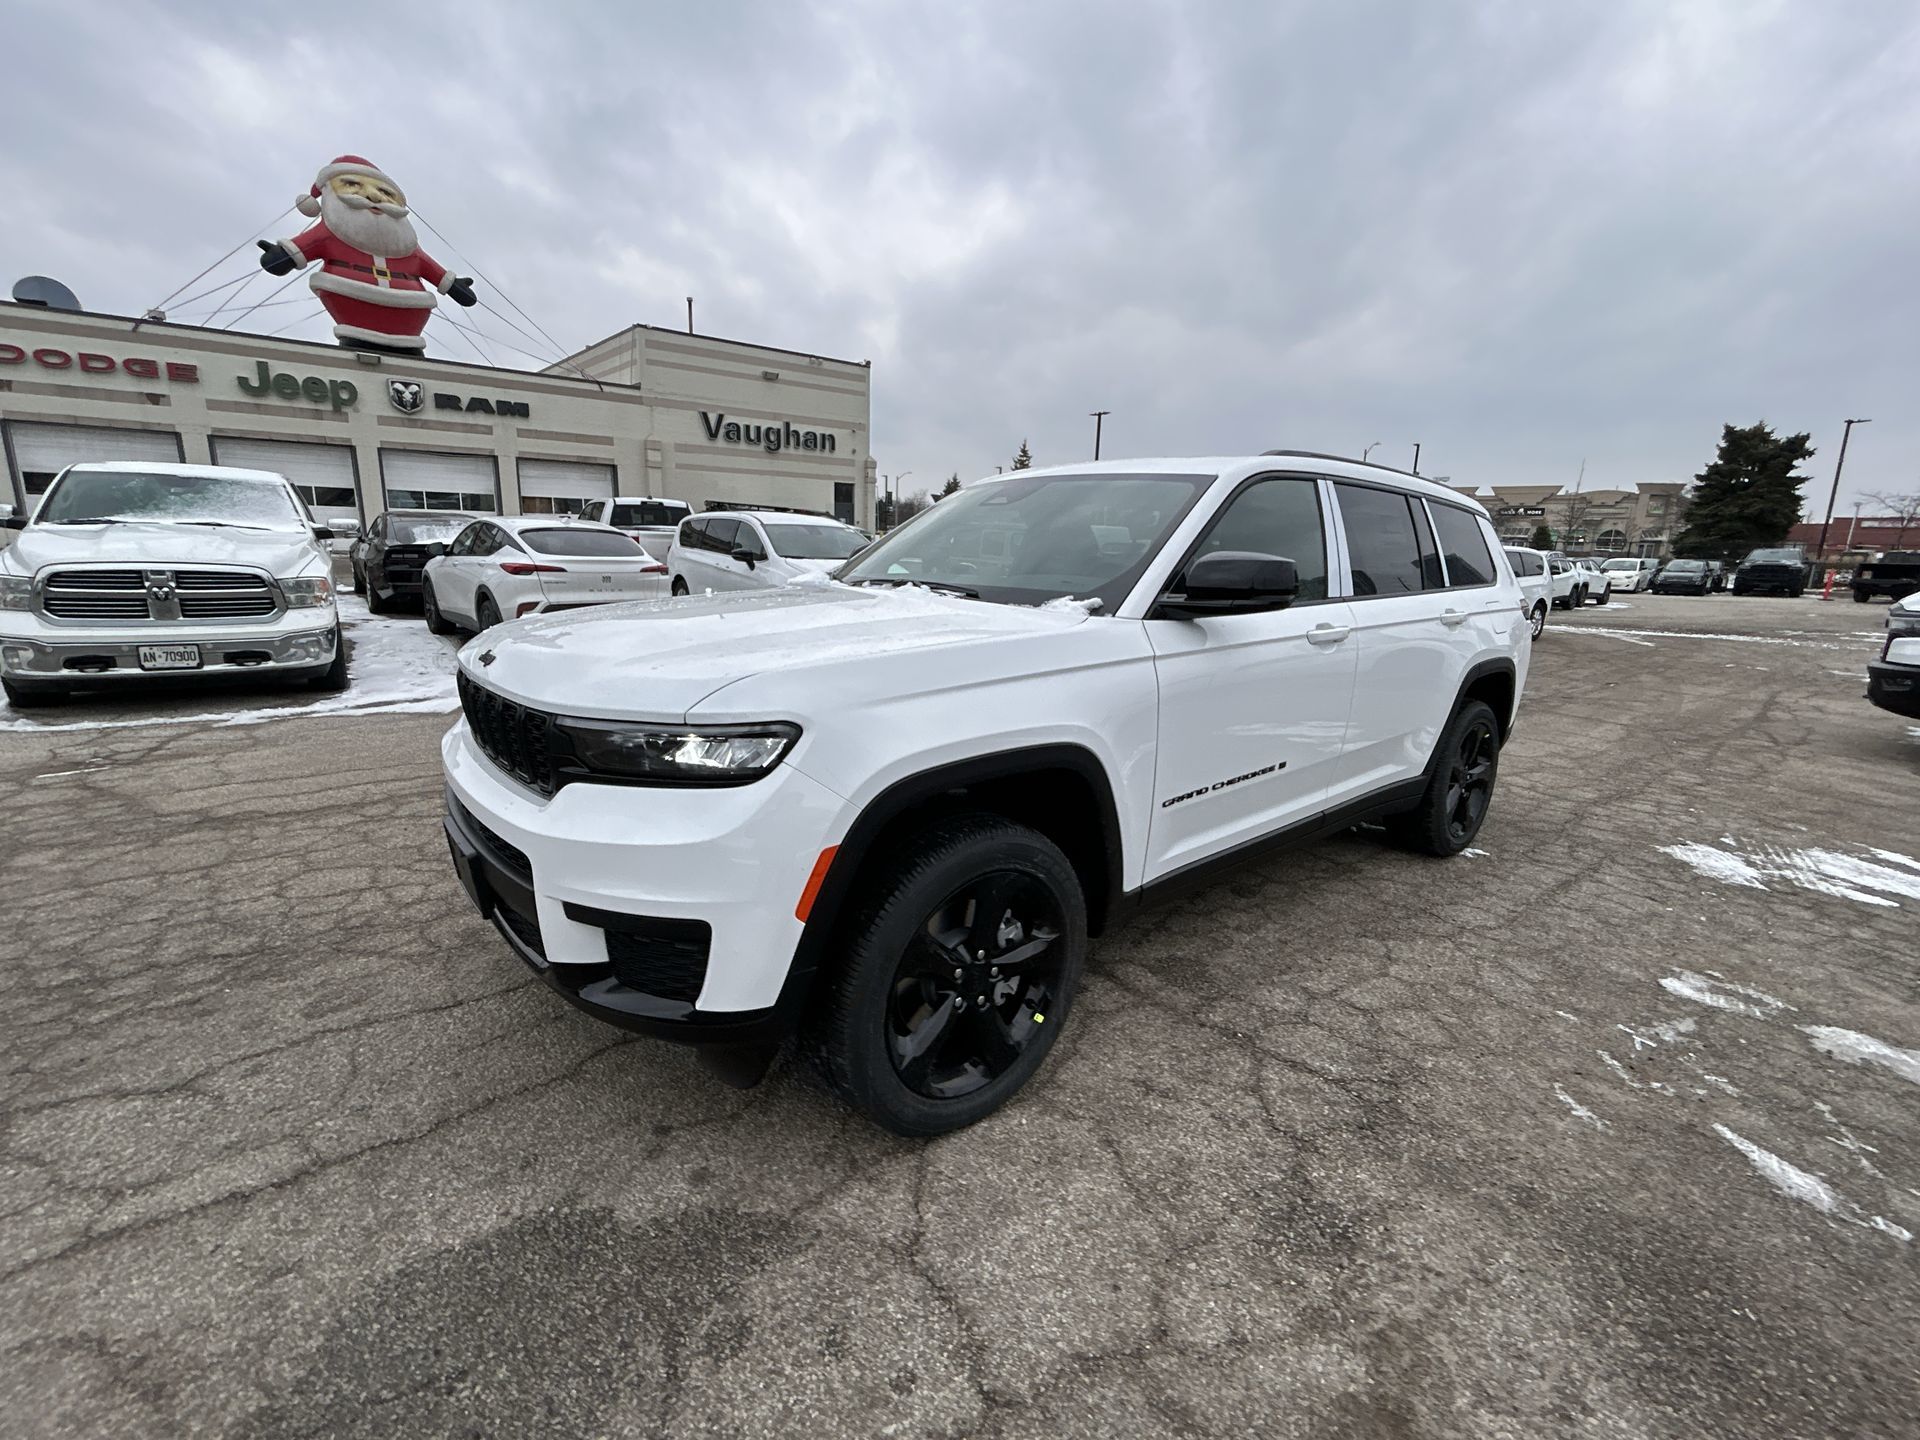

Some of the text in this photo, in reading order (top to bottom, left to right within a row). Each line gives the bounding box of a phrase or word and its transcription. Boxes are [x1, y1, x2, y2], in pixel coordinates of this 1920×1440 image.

[237, 360, 358, 412] Jeep
[434, 392, 530, 418] RAM
[698, 411, 836, 454] Vaughan
[1162, 765, 1276, 808] GRAND CHEROKEE
